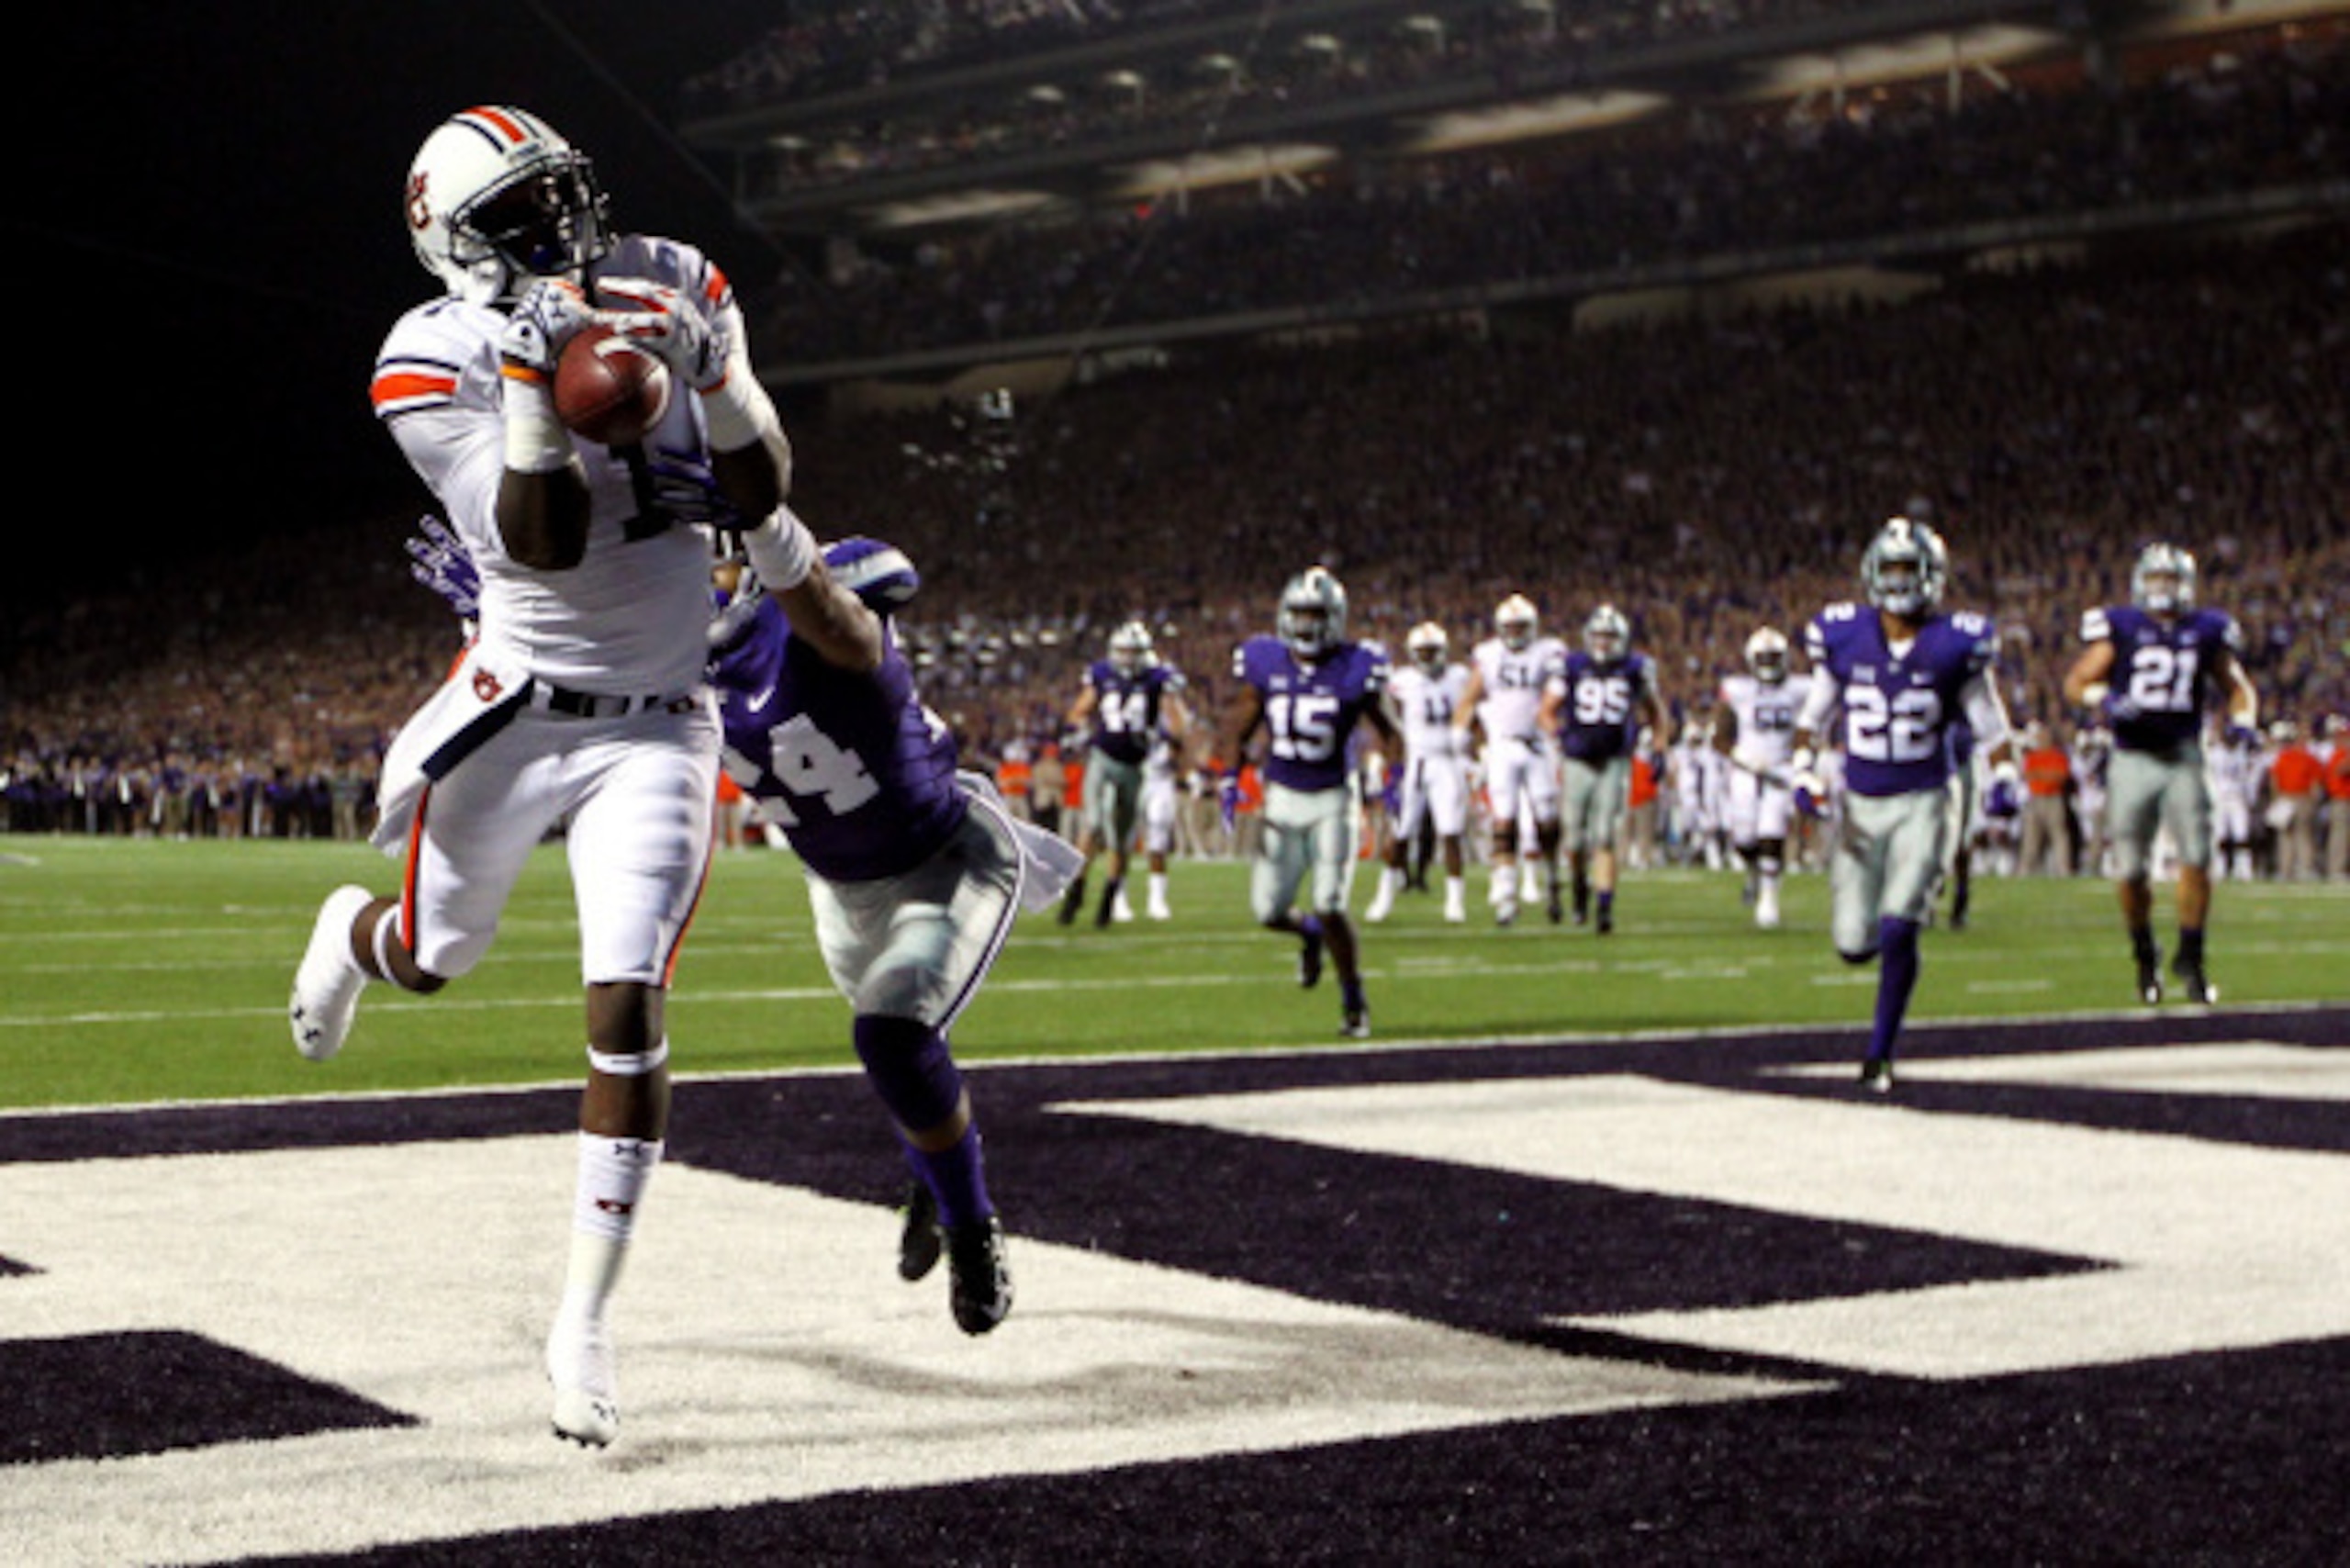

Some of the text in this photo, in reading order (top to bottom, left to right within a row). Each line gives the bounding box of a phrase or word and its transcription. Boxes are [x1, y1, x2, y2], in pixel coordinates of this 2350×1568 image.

[1498, 662, 1530, 689] 51
[2131, 645, 2198, 711] 21
[1101, 691, 1147, 733] 44
[1425, 696, 1453, 725] 11
[1574, 678, 1630, 724] 95
[1844, 684, 1942, 763] 22
[1266, 694, 1340, 761] 15
